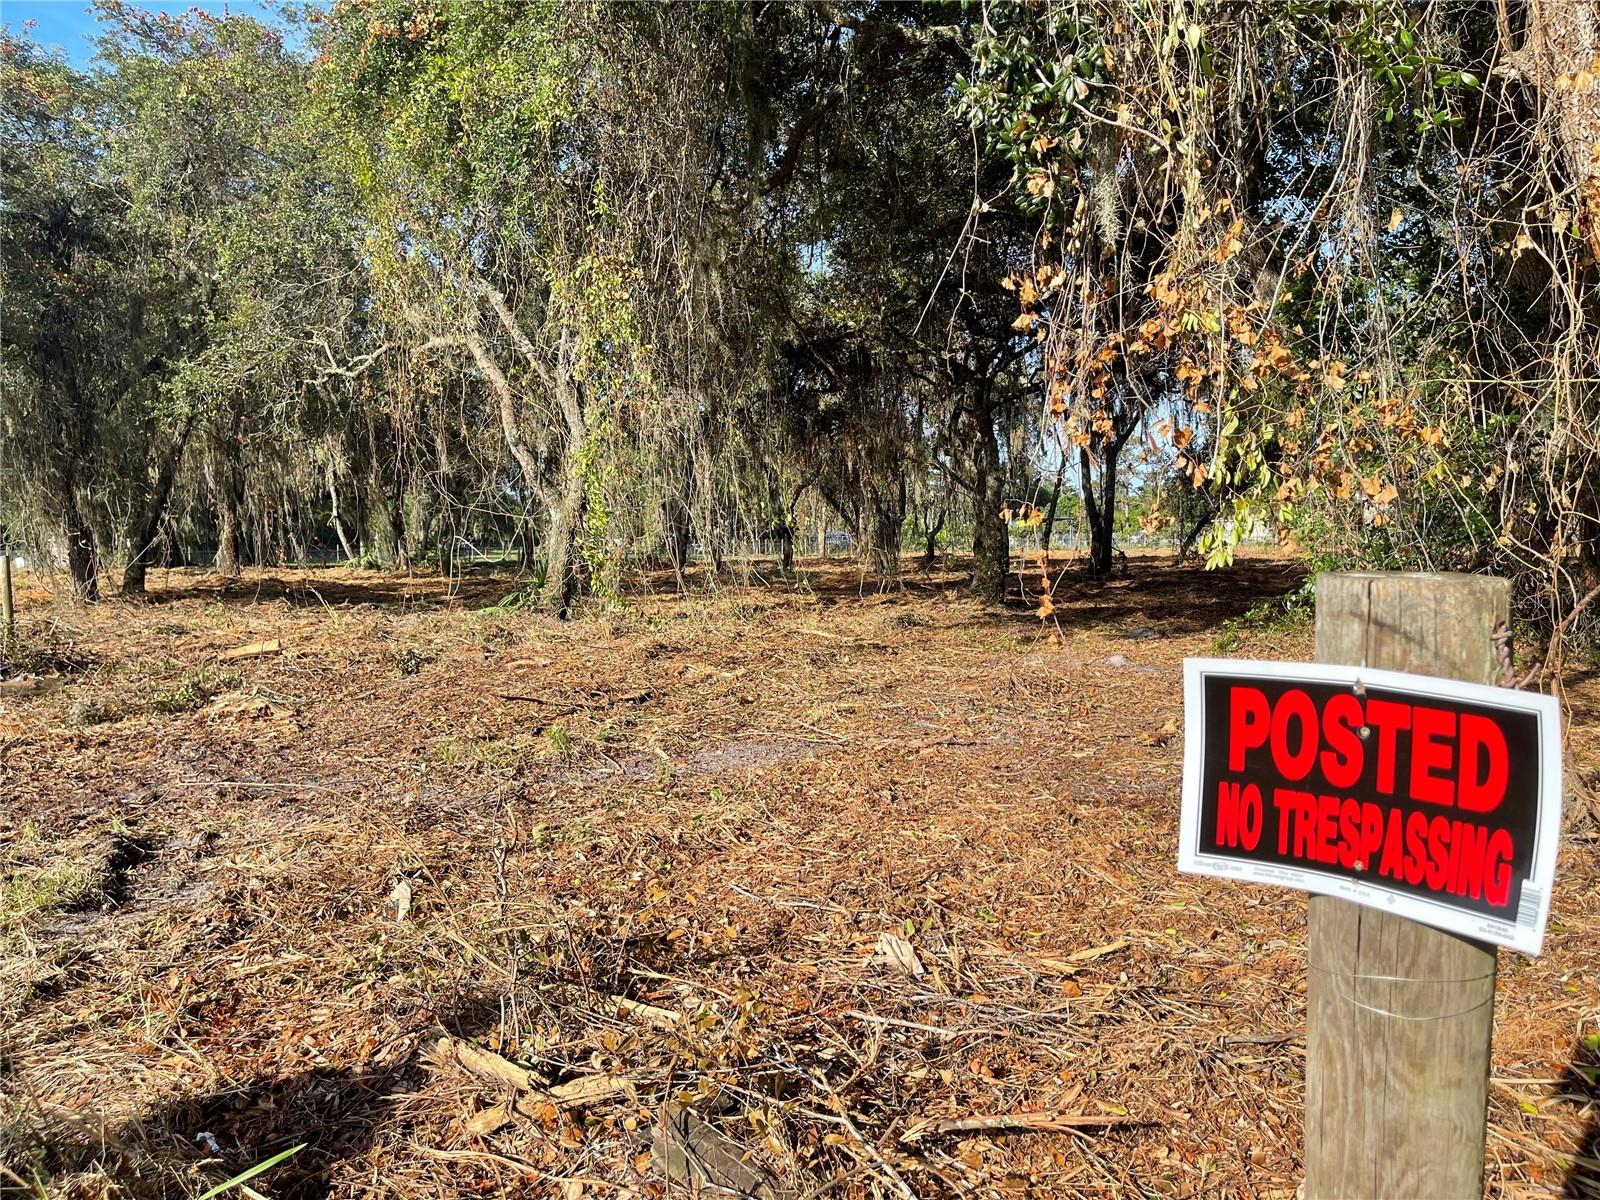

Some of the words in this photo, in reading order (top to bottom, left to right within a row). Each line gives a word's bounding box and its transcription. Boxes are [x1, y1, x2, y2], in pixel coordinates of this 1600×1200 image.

[1229, 686, 1510, 814] POSTED
[1215, 780, 1264, 852] NO
[1272, 788, 1515, 907] TRESPASSING
